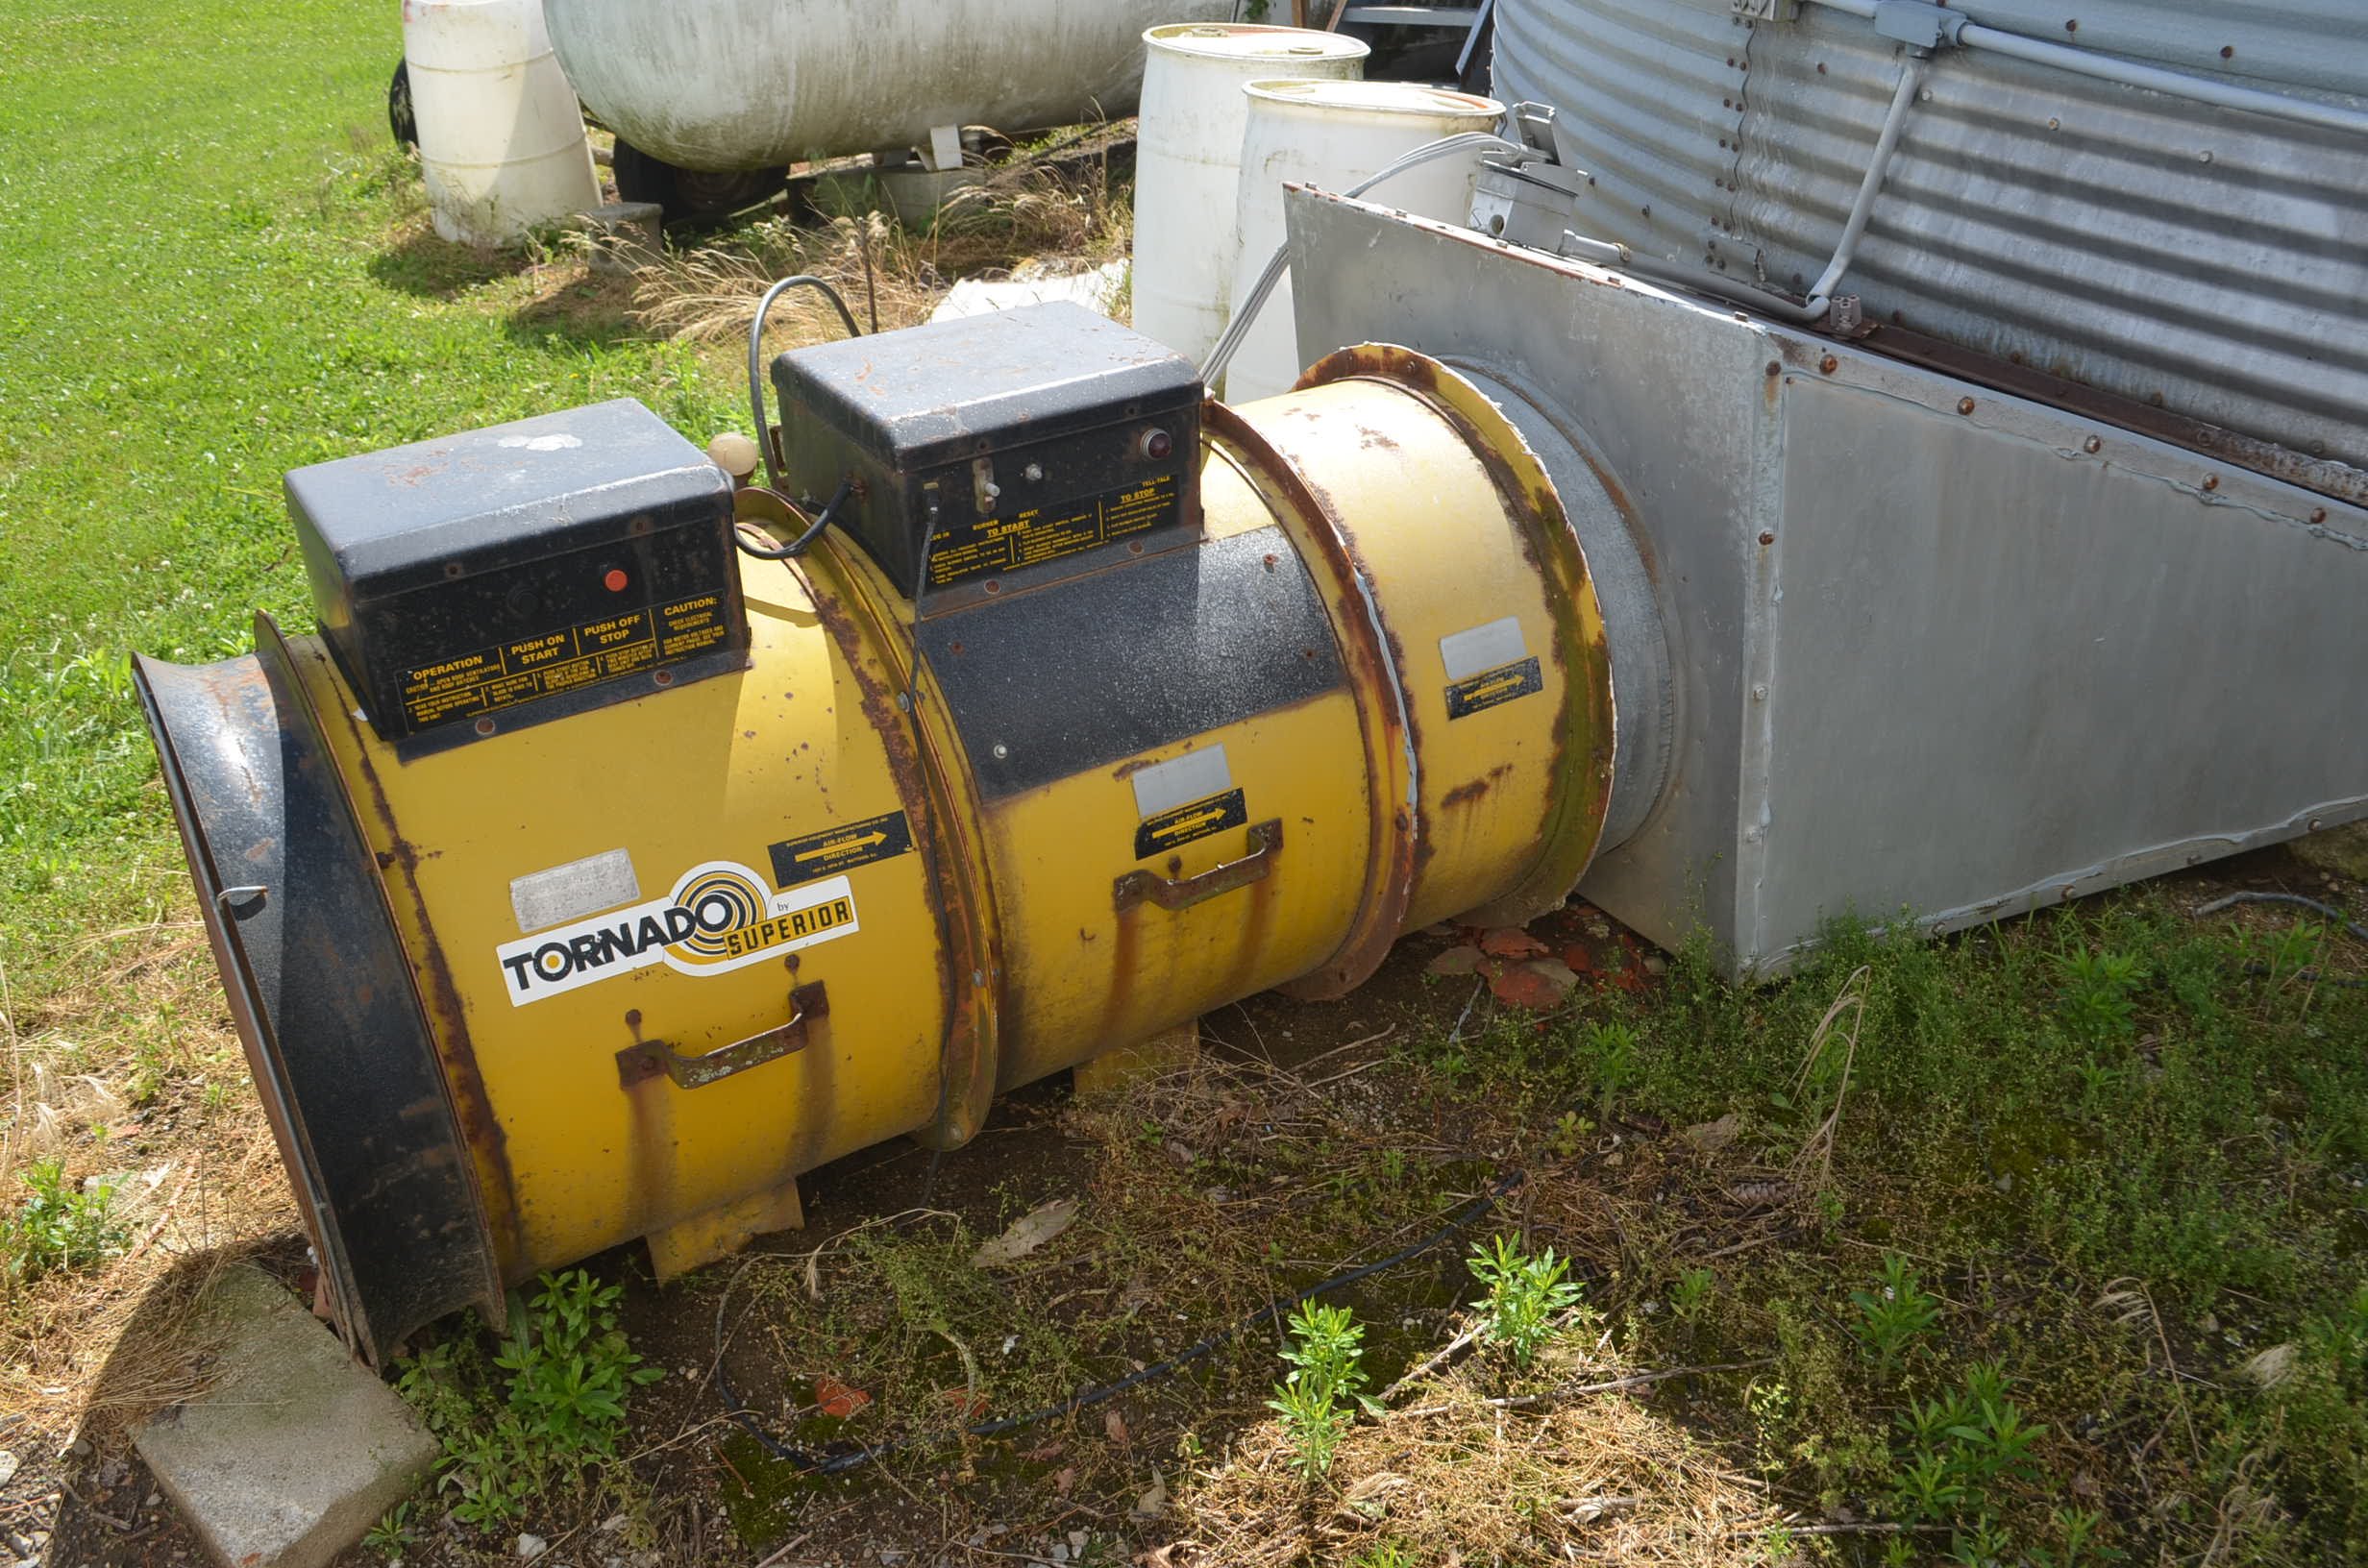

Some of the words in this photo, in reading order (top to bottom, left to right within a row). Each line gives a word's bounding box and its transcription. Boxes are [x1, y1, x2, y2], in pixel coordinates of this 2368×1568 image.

[1122, 494, 1132, 502] TO
[1134, 488, 1155, 500] STOP
[1019, 509, 1038, 520] RESET
[987, 527, 999, 537] TO
[1001, 520, 1030, 533] START
[664, 597, 718, 616] CAUTION:
[583, 621, 616, 636] PUSH
[619, 615, 641, 627] OFF
[511, 639, 544, 654] PUSH
[547, 634, 565, 646] ON
[600, 629, 629, 644] STOP
[522, 647, 559, 665] START
[413, 655, 482, 680] OPERATION
[824, 845, 863, 862] DIRECTION
[728, 901, 850, 956] SUPERIOR
[503, 894, 733, 991] TORNADO
[777, 901, 790, 912] by
